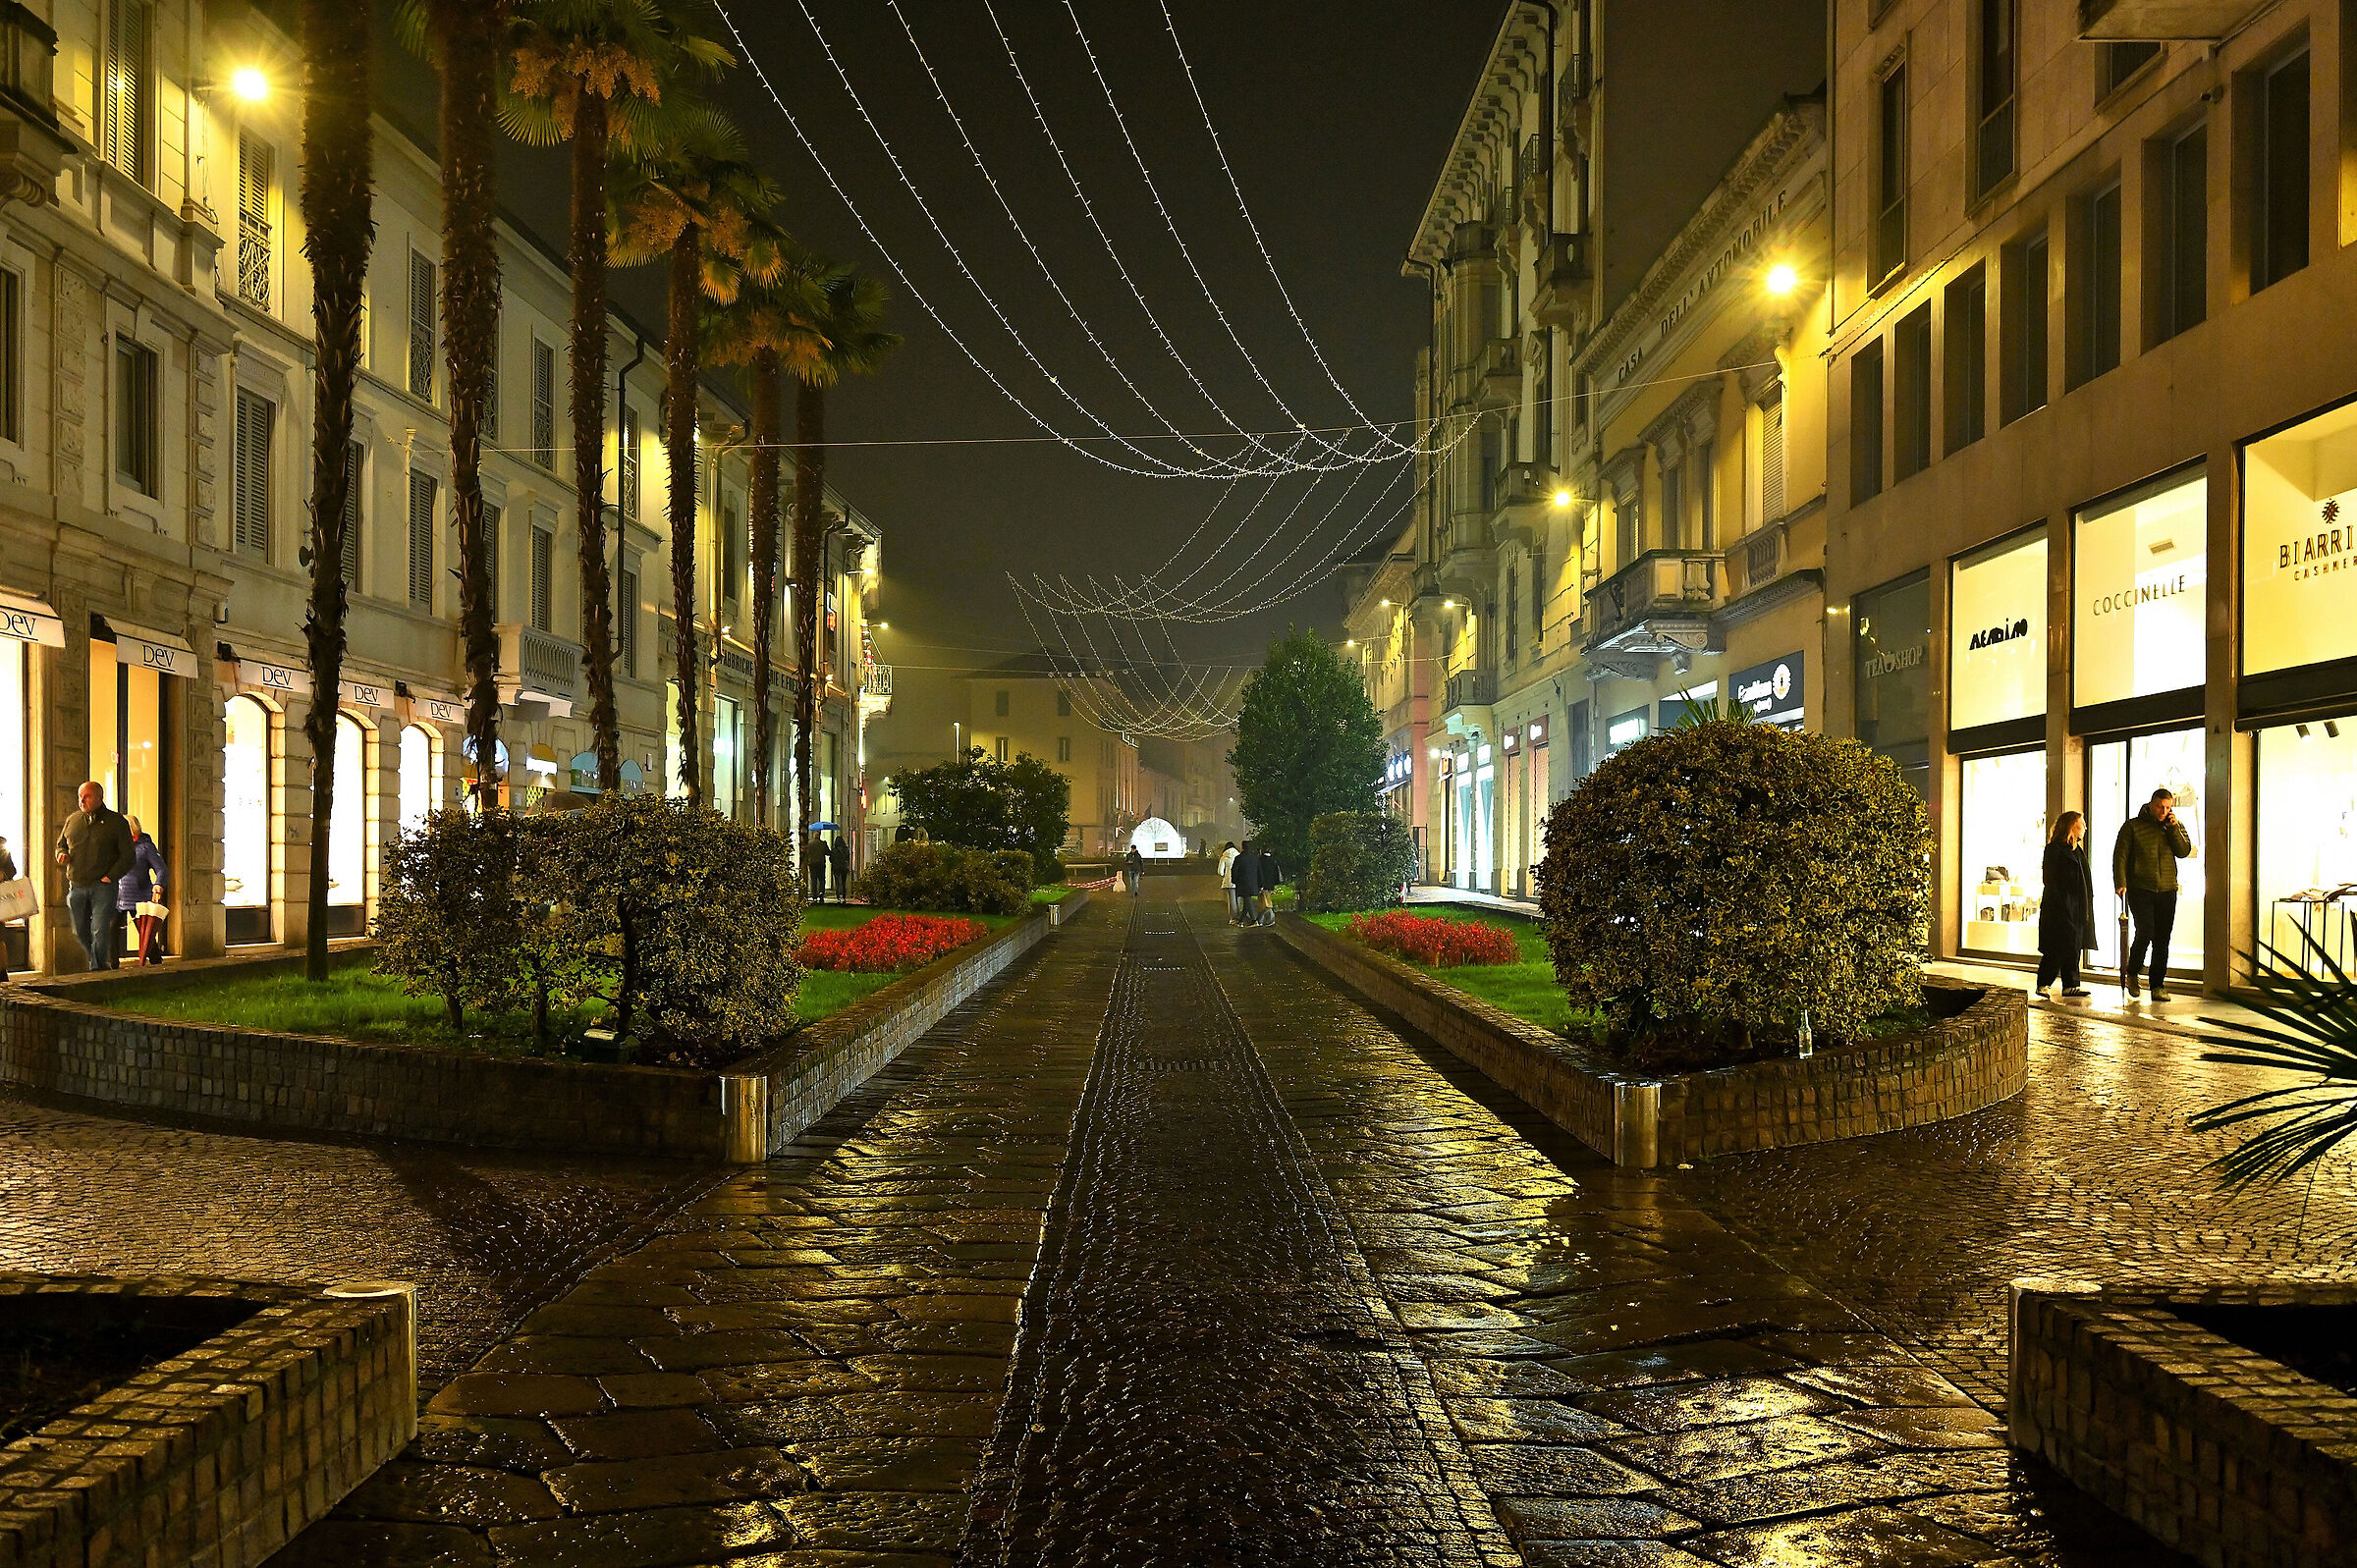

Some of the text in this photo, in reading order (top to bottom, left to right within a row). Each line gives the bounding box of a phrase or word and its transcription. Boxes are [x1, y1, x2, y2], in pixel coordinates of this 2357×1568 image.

[1618, 347, 1643, 383] CASA
[2279, 525, 2354, 568] BIARRI
[2093, 574, 2185, 616] COCCINELLE
[1865, 645, 1923, 678] TEA SHOP
